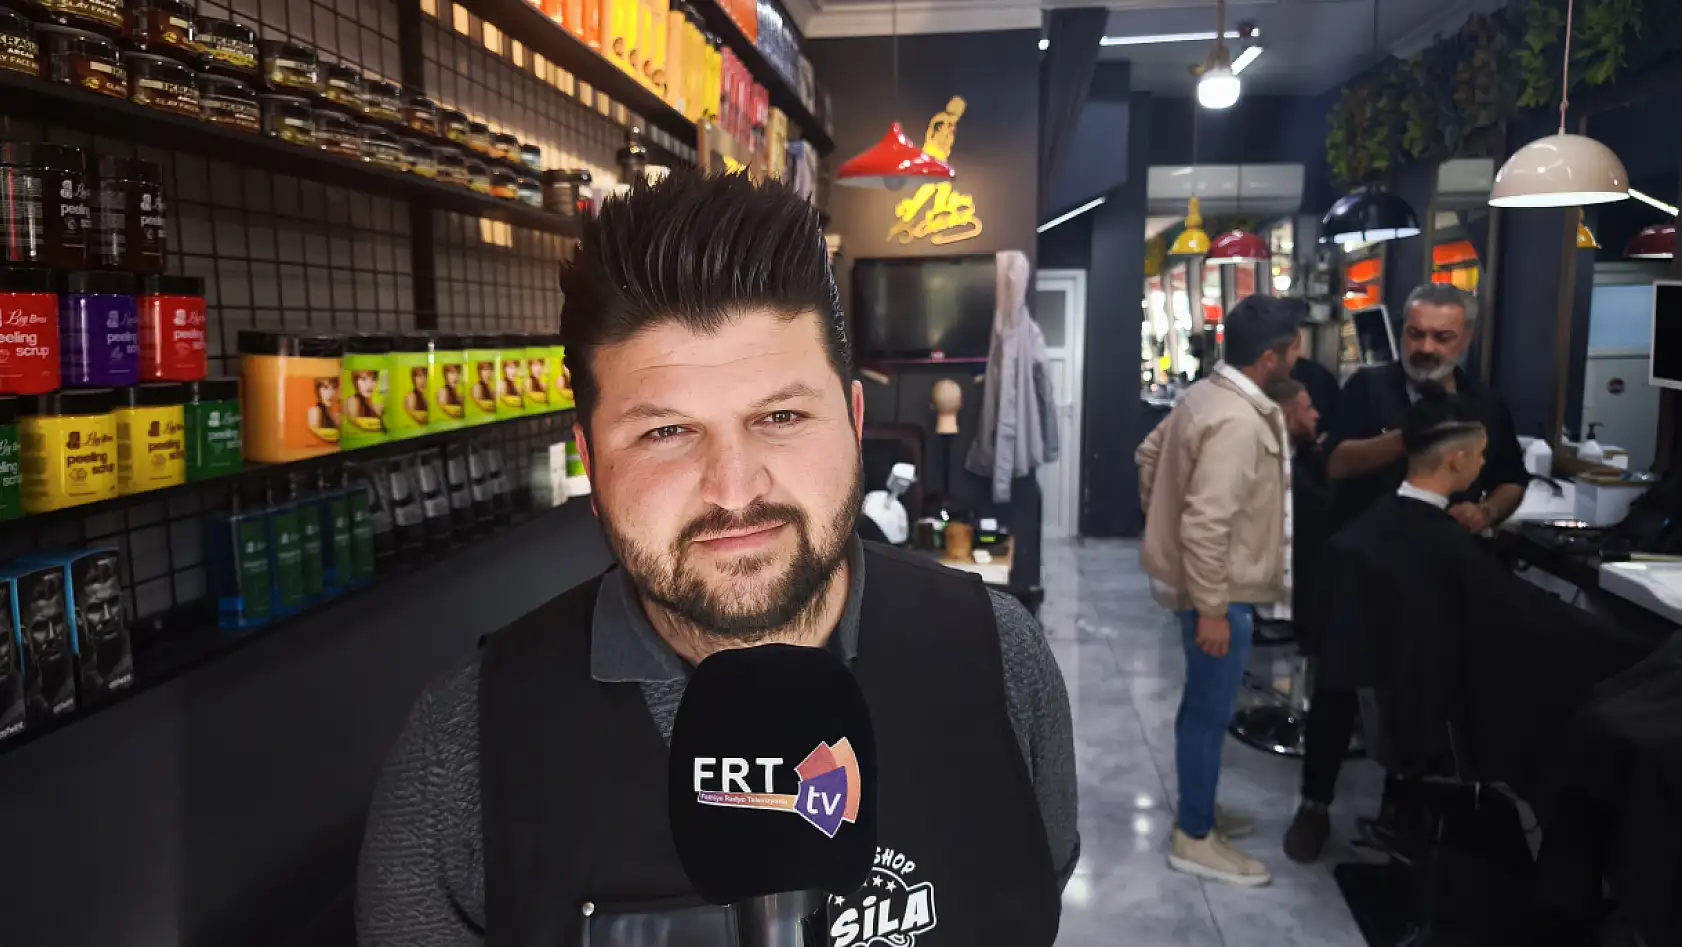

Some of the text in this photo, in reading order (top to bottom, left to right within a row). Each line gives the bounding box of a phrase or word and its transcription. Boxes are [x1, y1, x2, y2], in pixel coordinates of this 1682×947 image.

[15, 347, 49, 360] scrup
[66, 451, 108, 468] peeling
[694, 757, 783, 793] FRT
[806, 785, 842, 815] tv
